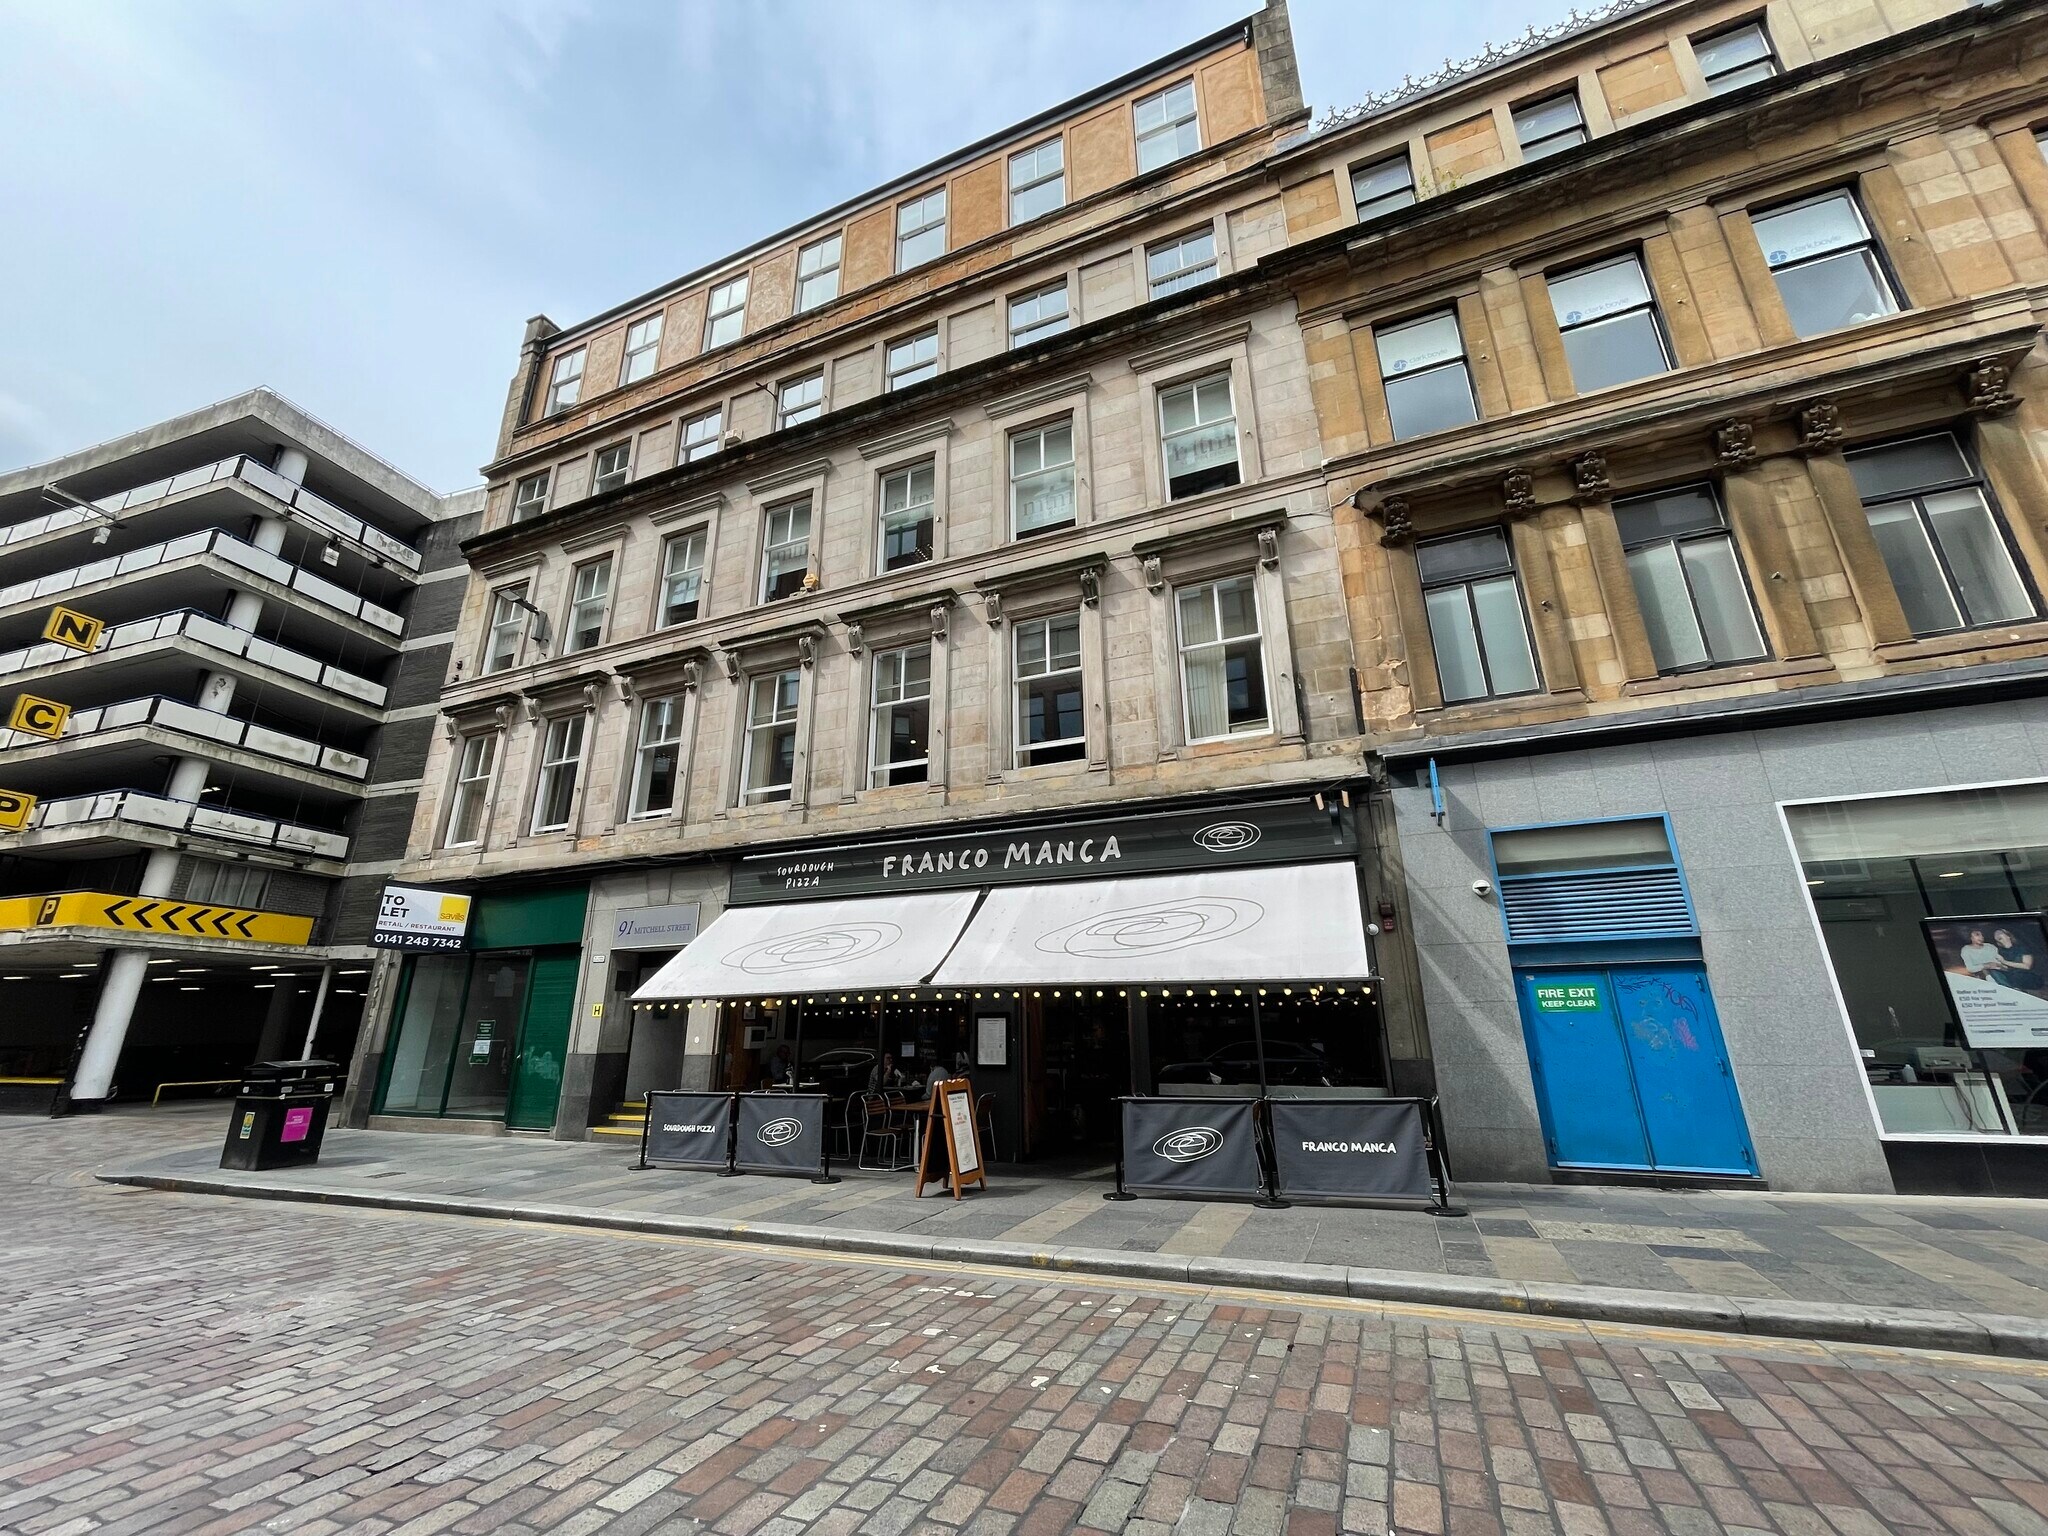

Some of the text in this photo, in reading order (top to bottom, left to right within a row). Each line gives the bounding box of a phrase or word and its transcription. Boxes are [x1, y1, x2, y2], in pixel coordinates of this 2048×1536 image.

[56, 614, 92, 644] N
[25, 704, 57, 730] C
[883, 835, 1122, 878] FRANCO MANCA
[777, 862, 834, 877] SOURDOUGH
[785, 876, 820, 889] PIZZA
[385, 895, 406, 906] TO
[40, 900, 57, 923] P
[381, 906, 409, 918] LET
[440, 912, 465, 922] savills
[410, 923, 456, 932] RESTAURANT
[618, 920, 692, 937] 91 MITCHELL STREET
[374, 933, 462, 949] 0141 248 7342
[1537, 988, 1596, 999] FIRE EXIT
[1542, 1000, 1596, 1008] KEEP CLEAR
[593, 1006, 601, 1016] H
[663, 1123, 716, 1133] SOURDOUGH PIZZA
[1302, 1141, 1397, 1153] FRANCO MANCA
